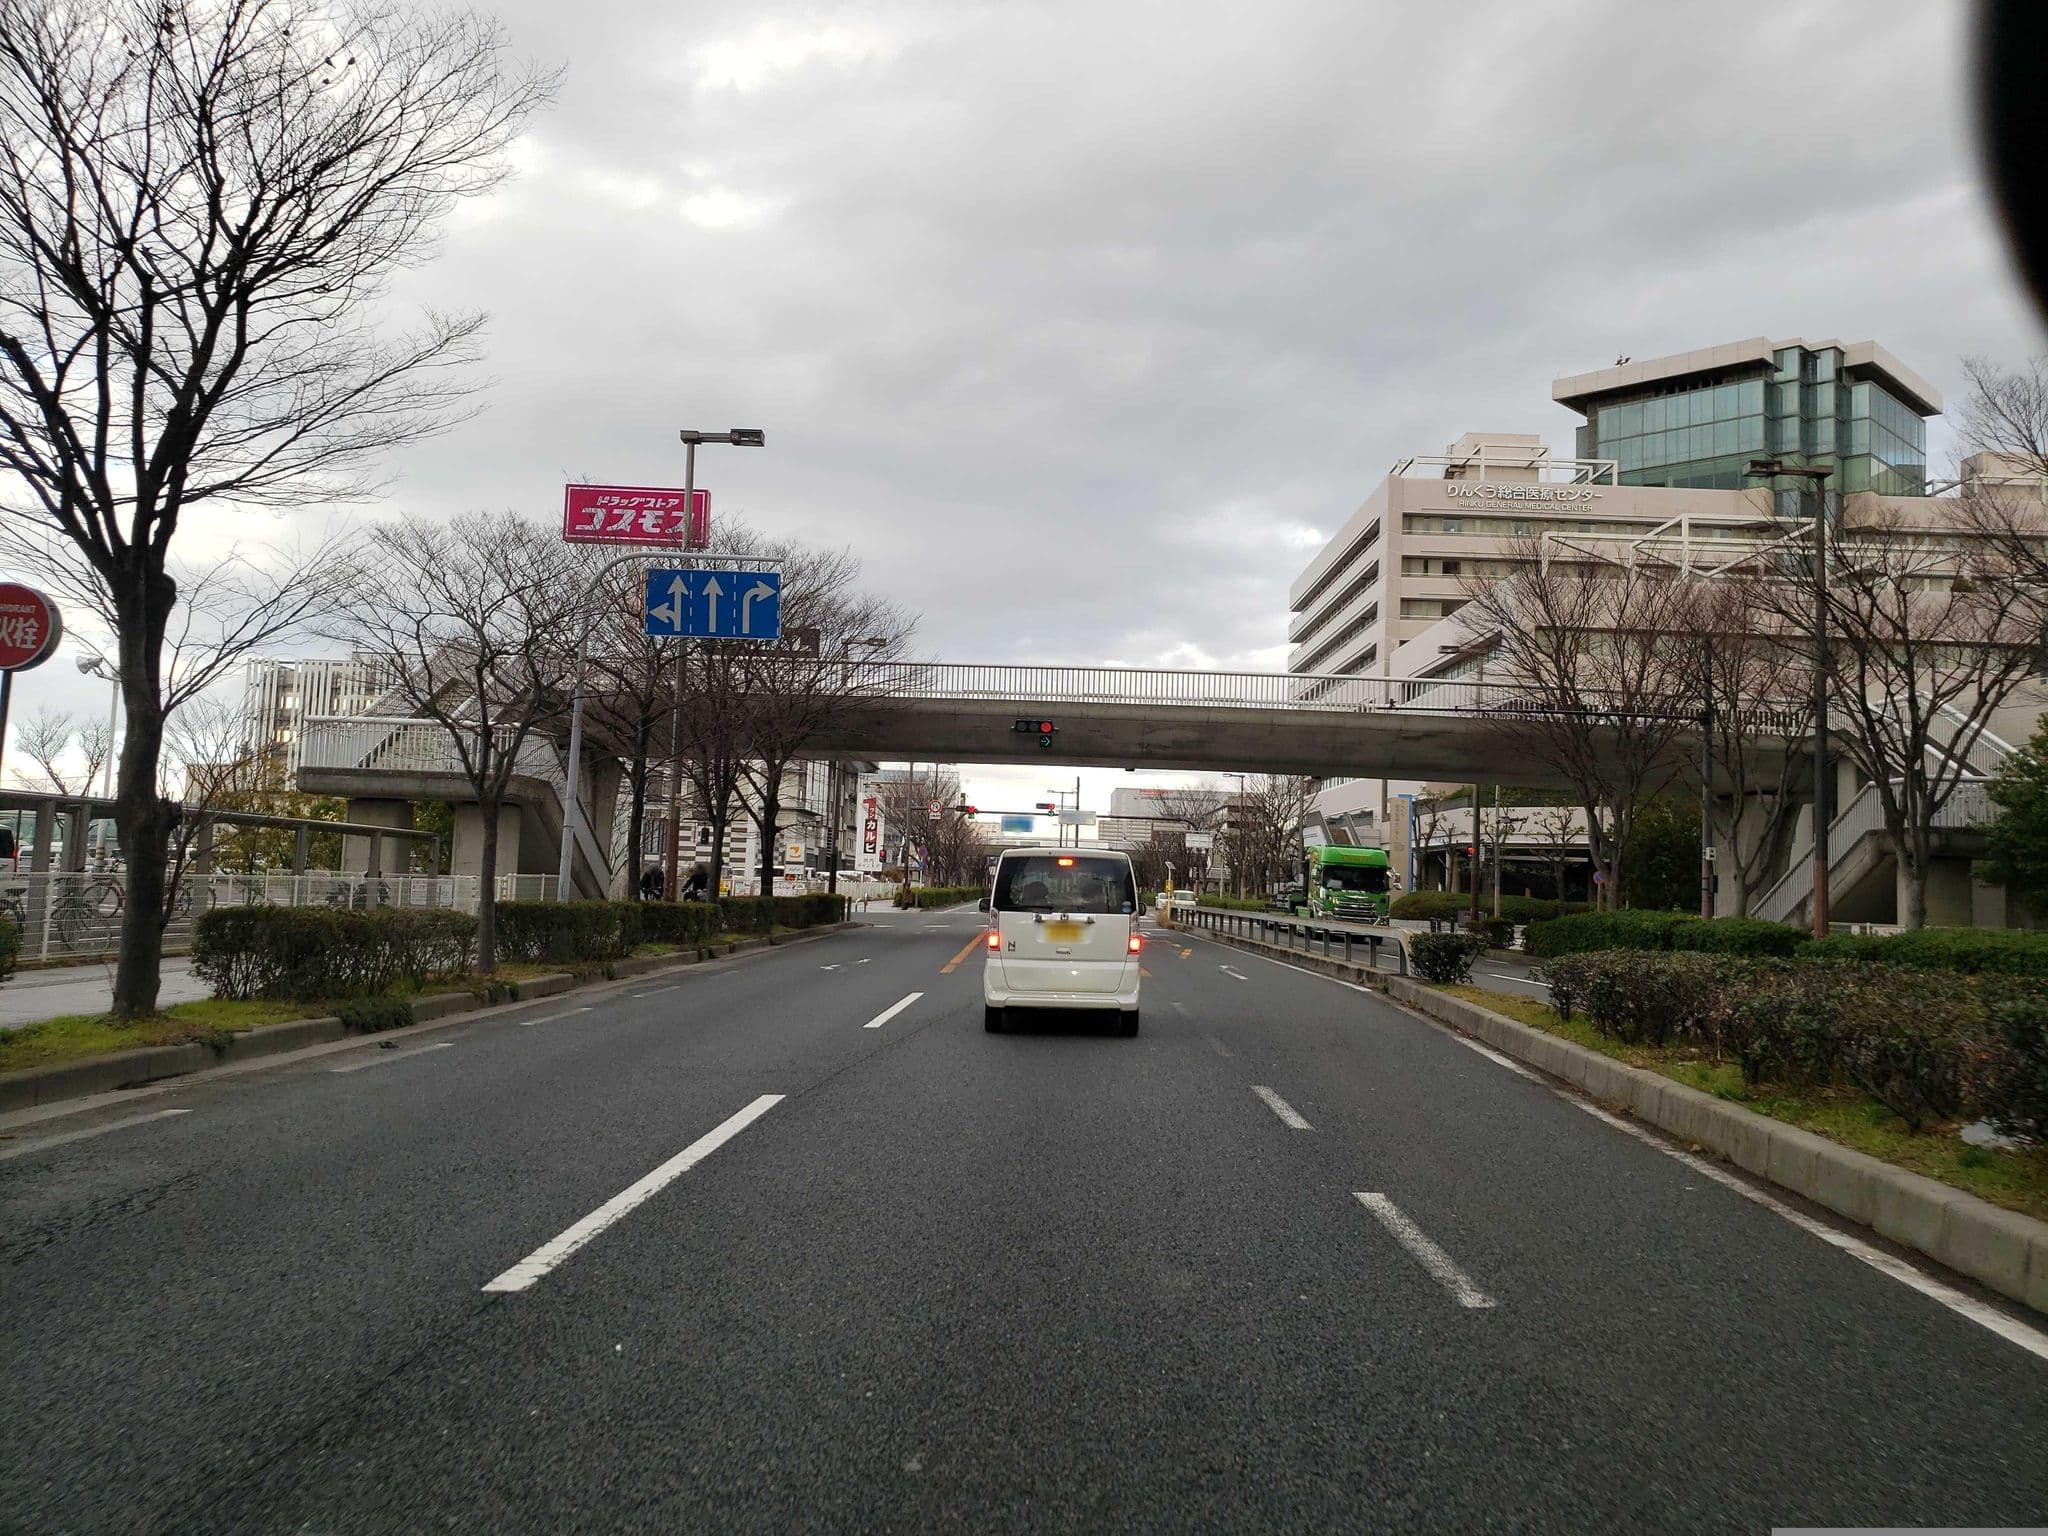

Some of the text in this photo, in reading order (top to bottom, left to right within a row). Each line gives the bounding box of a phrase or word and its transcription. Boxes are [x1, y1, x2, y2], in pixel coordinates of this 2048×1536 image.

[1447, 483, 1603, 501] りんくう総合医療センター
[597, 495, 680, 508] ドラッグストア
[1485, 501, 1522, 509] GENERAL
[1524, 502, 1560, 510] MEDICAL
[1561, 503, 1593, 511] CENTER
